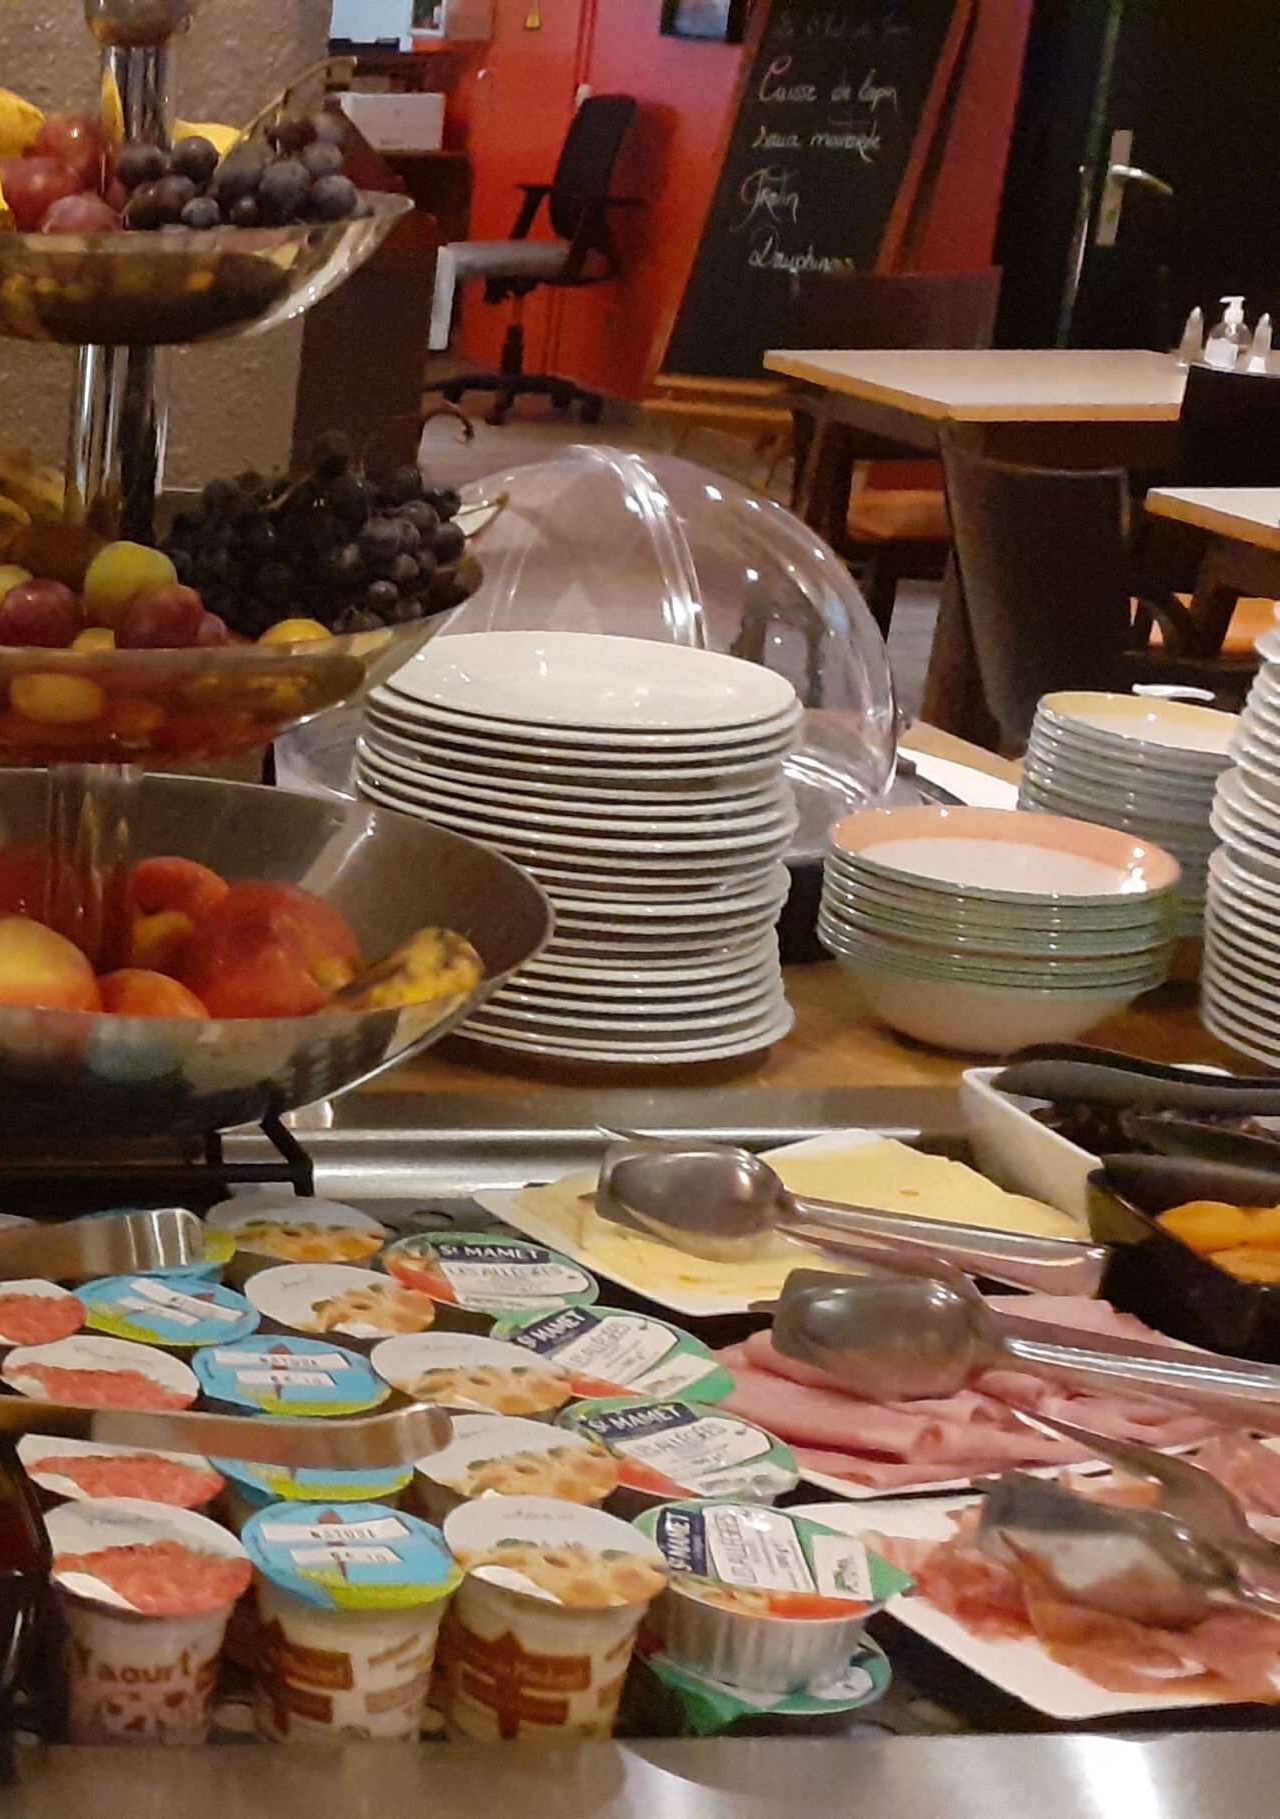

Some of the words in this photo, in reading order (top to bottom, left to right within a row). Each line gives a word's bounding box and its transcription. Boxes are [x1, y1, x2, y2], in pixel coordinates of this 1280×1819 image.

[463, 1246, 539, 1260] MAMET
[533, 1310, 587, 1342] MAMET
[610, 1405, 682, 1430] MAMET
